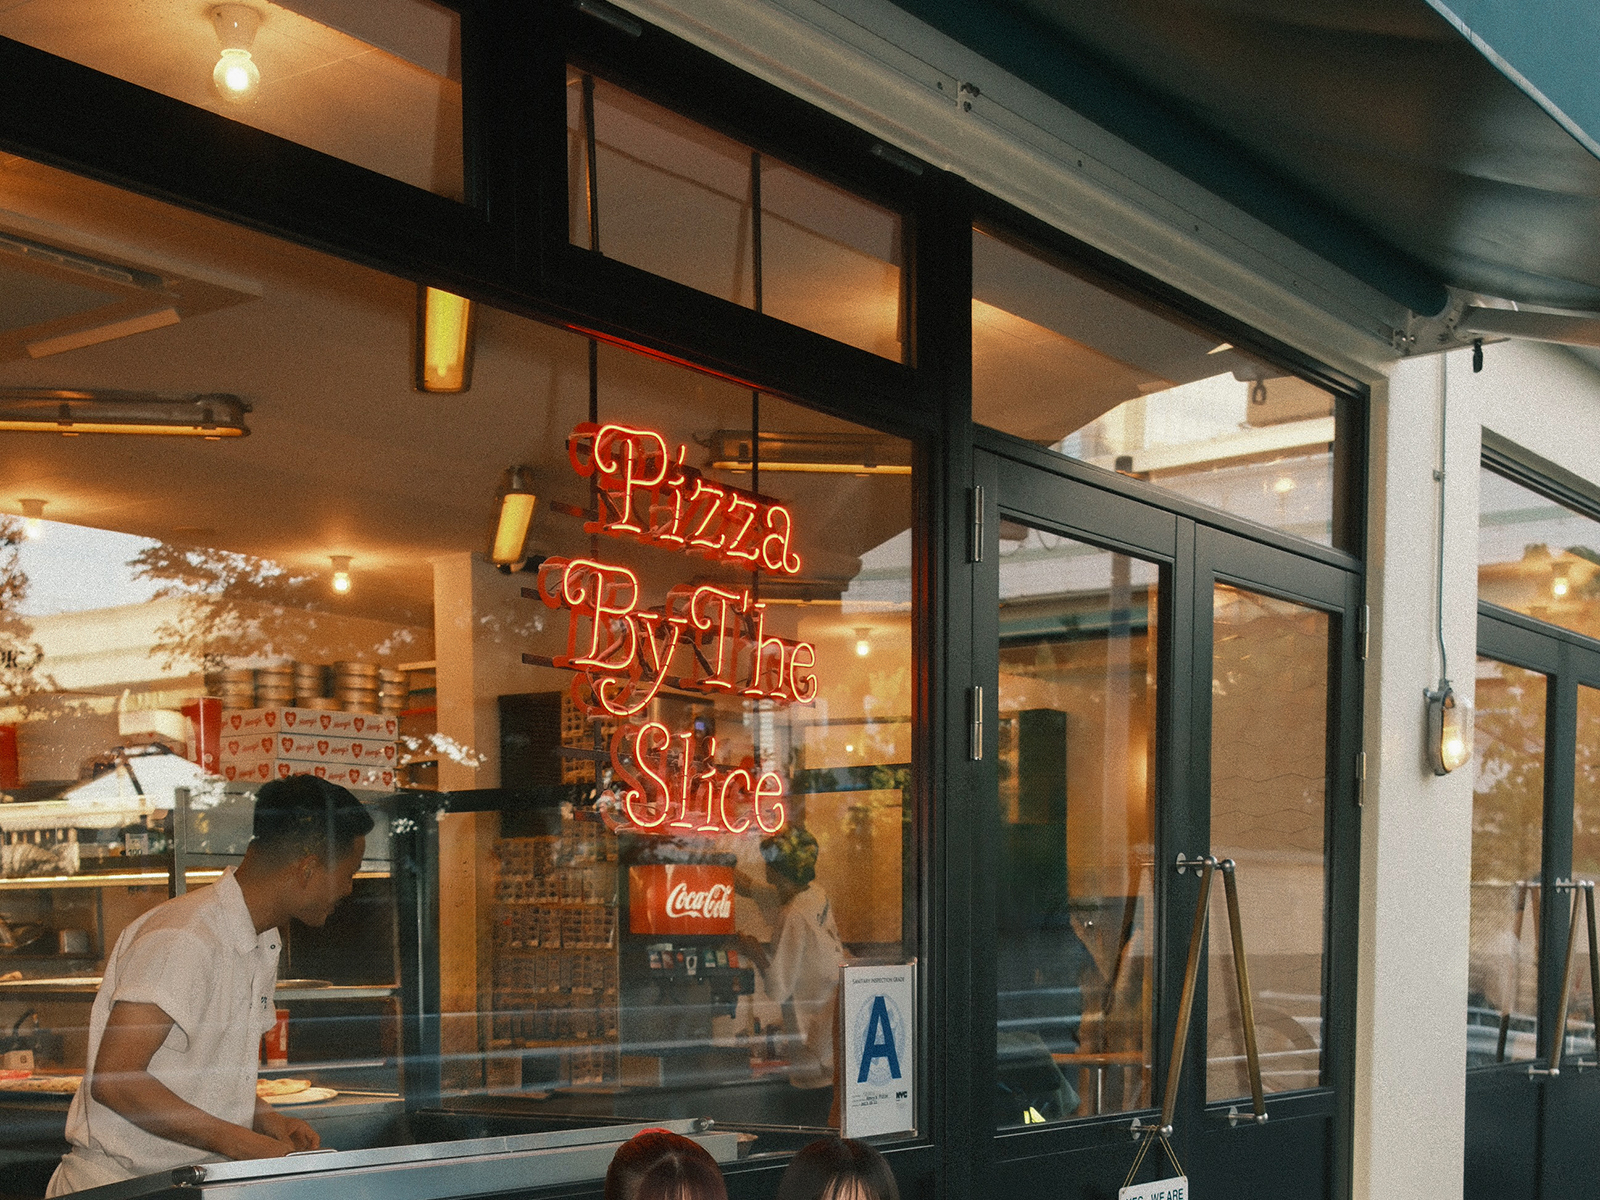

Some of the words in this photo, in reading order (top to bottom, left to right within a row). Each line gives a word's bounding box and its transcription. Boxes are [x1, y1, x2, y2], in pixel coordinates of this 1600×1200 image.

[593, 424, 801, 574] Pizza
[564, 558, 688, 717] By
[691, 584, 819, 703] The
[625, 721, 785, 835] Slice
[666, 882, 733, 918] Coca-Cola
[857, 995, 902, 1084] A
[895, 1091, 908, 1099] NYC
